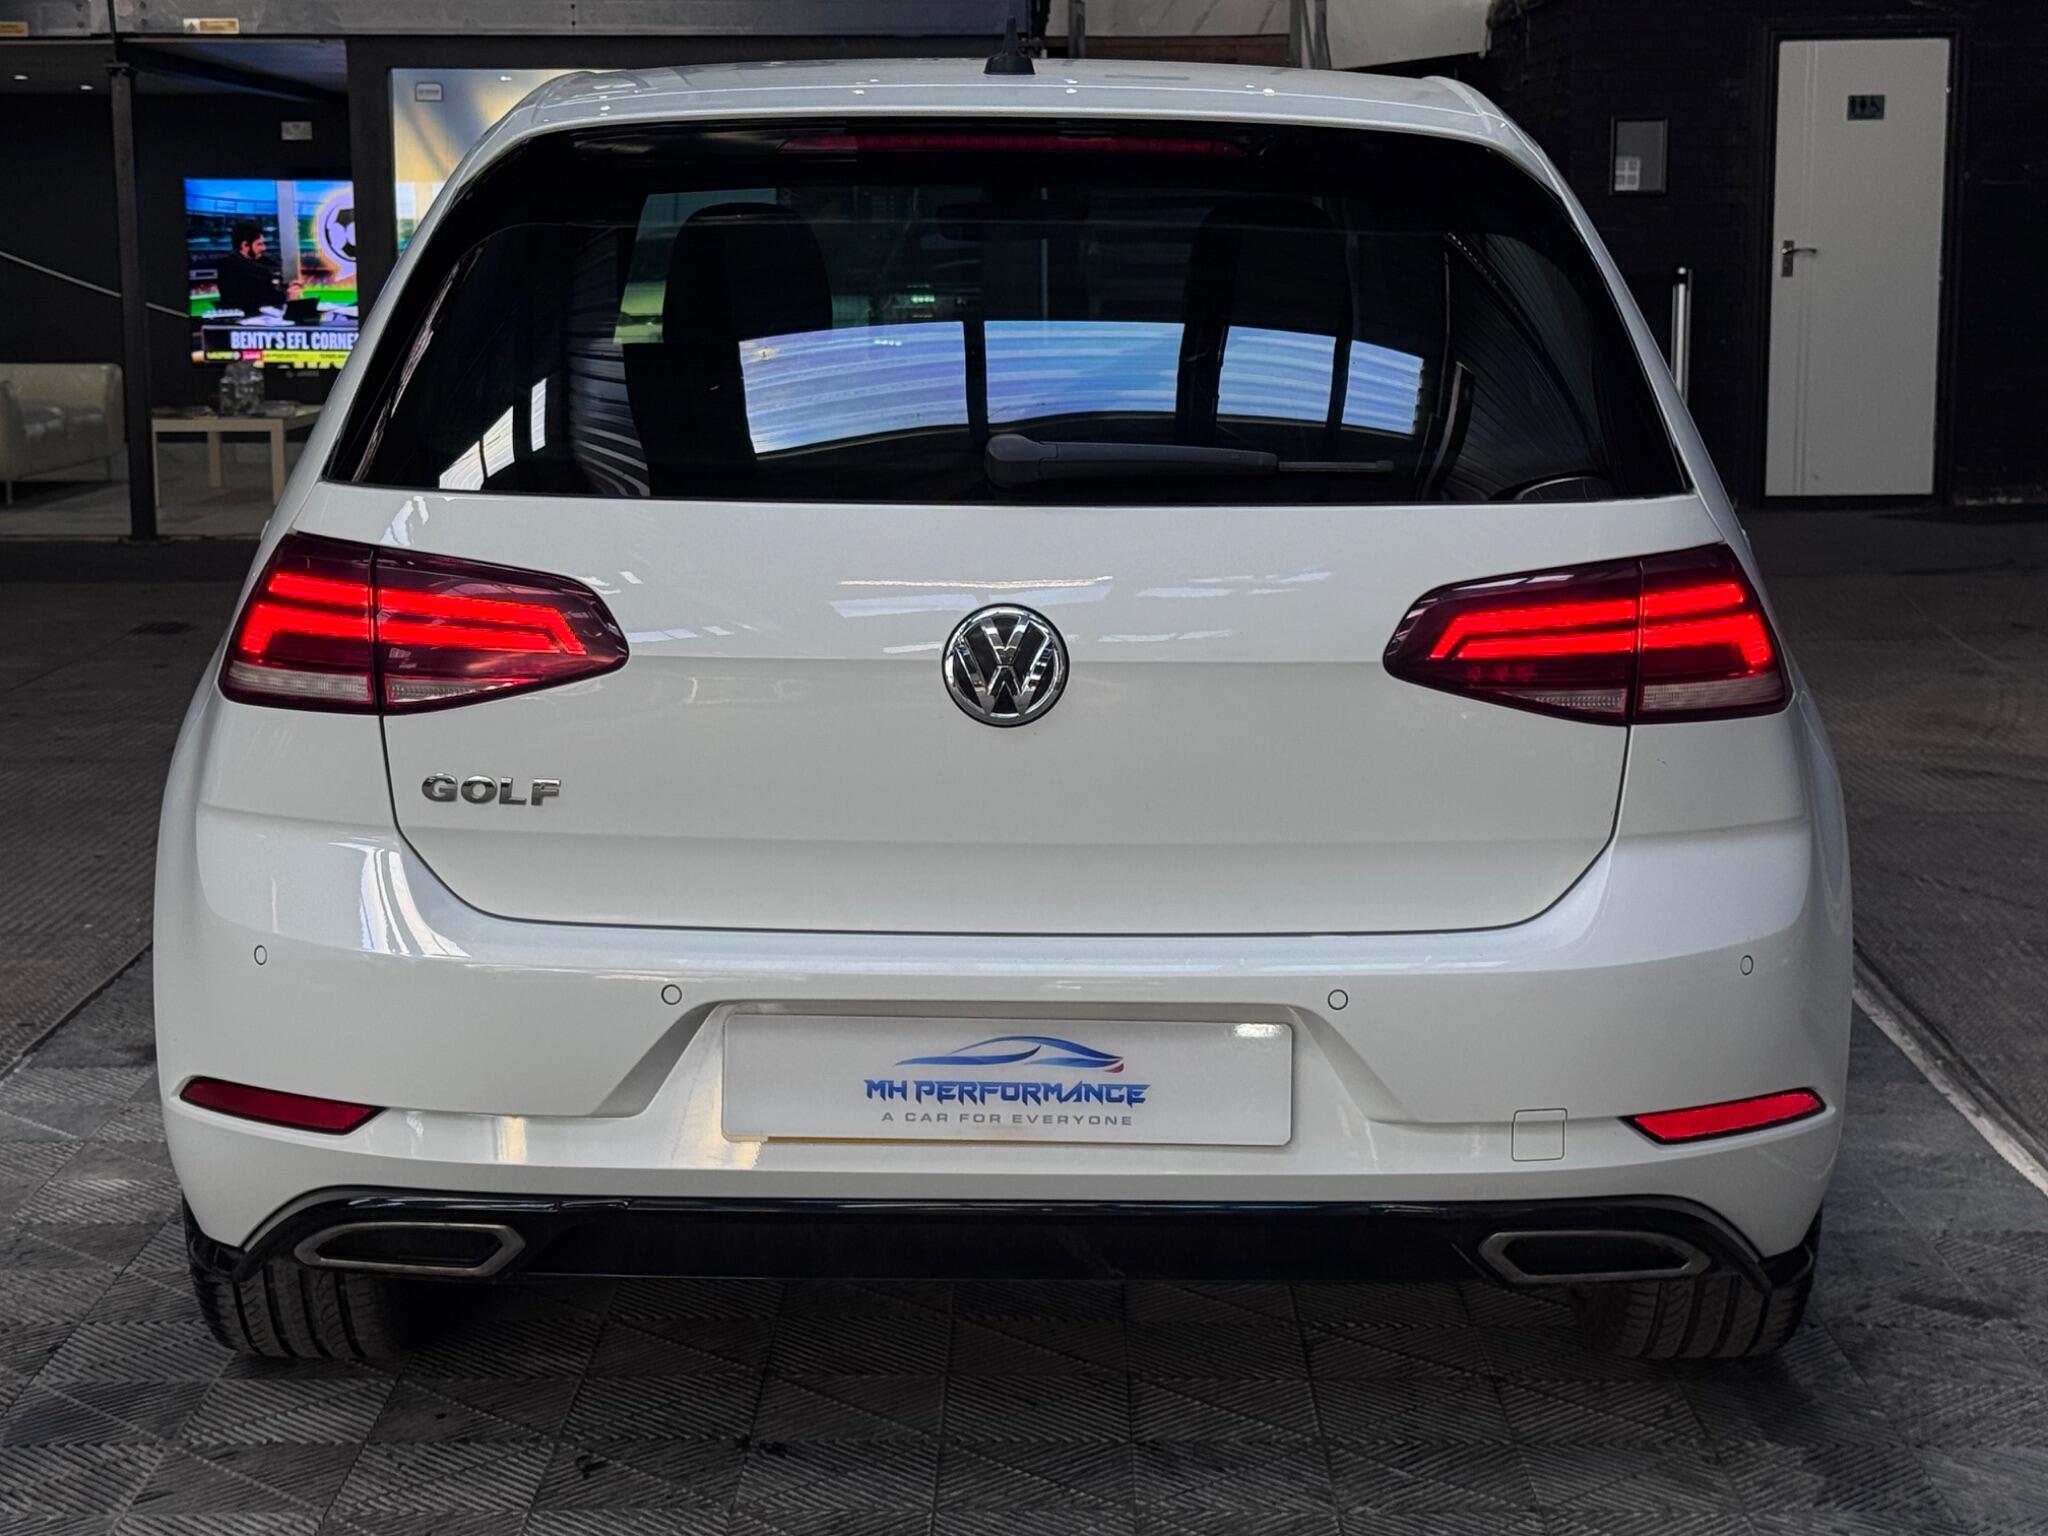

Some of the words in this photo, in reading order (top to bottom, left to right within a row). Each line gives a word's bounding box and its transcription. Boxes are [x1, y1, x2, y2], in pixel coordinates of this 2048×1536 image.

[230, 331, 285, 349] BENTY'S
[286, 331, 310, 349] EFL
[421, 772, 561, 806] GOLF
[863, 1079, 908, 1101] MH
[914, 1080, 1151, 1108] PERFORMANCE
[881, 1112, 895, 1122] A
[905, 1112, 948, 1123] CAR
[959, 1113, 1001, 1123] FOR
[1012, 1114, 1132, 1126] EVERYONE
